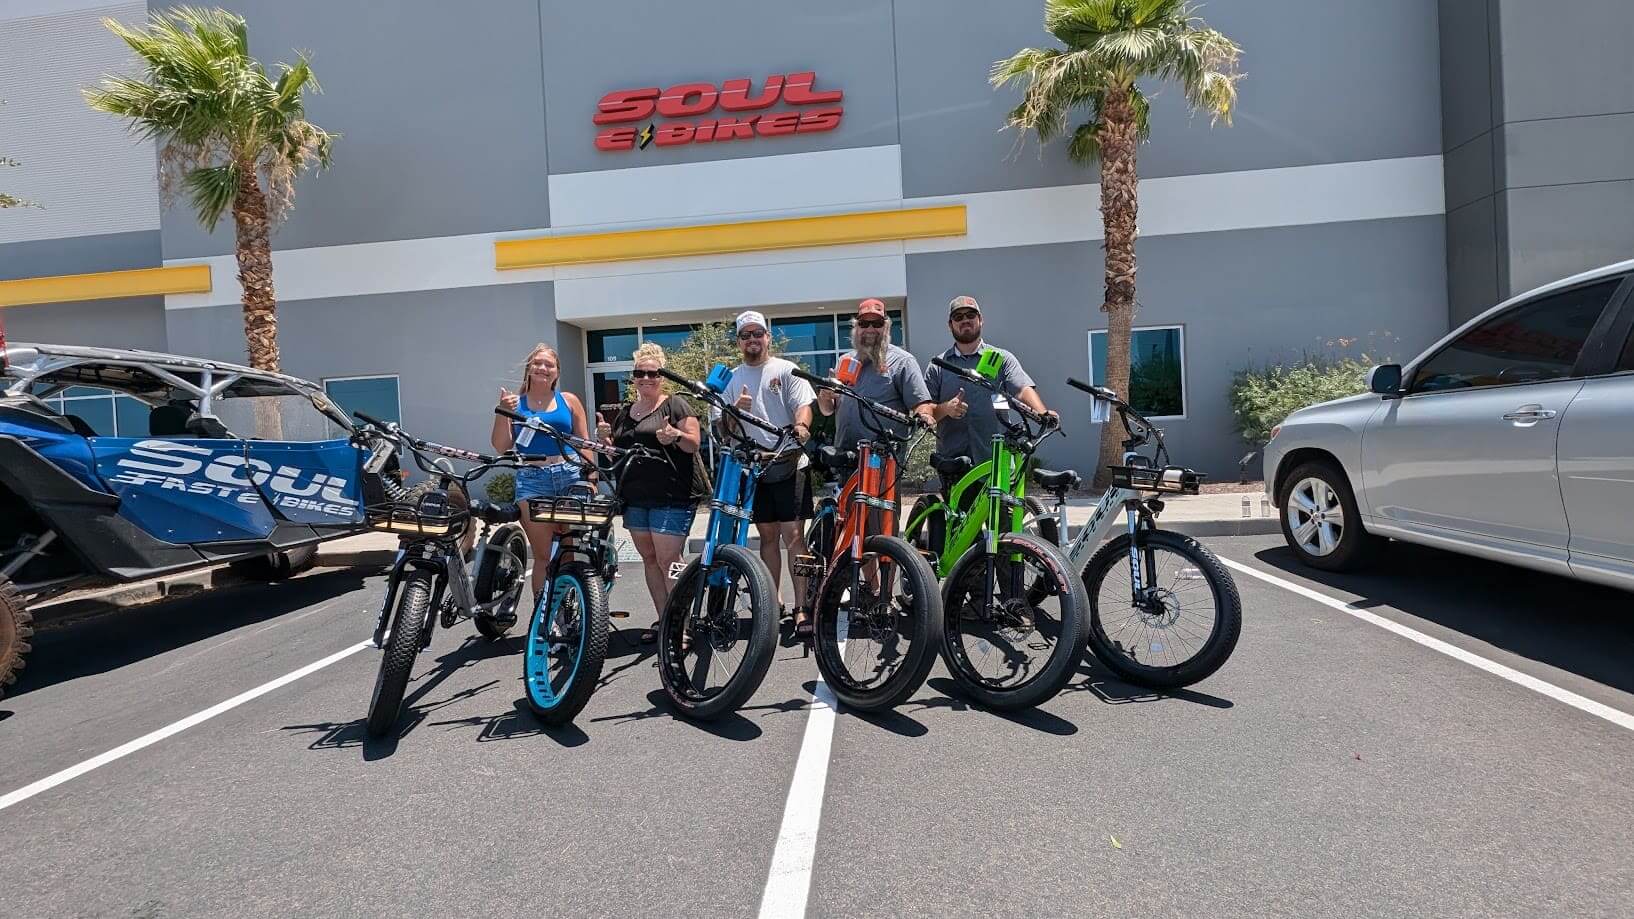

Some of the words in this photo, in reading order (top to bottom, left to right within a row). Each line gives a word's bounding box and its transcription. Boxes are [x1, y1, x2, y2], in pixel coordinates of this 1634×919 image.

[593, 71, 843, 125] SOUL
[594, 127, 637, 151] E
[655, 107, 843, 147] BIKES
[109, 470, 240, 497] FAST
[279, 496, 355, 516] BIKES
[117, 440, 360, 507] SOUL
